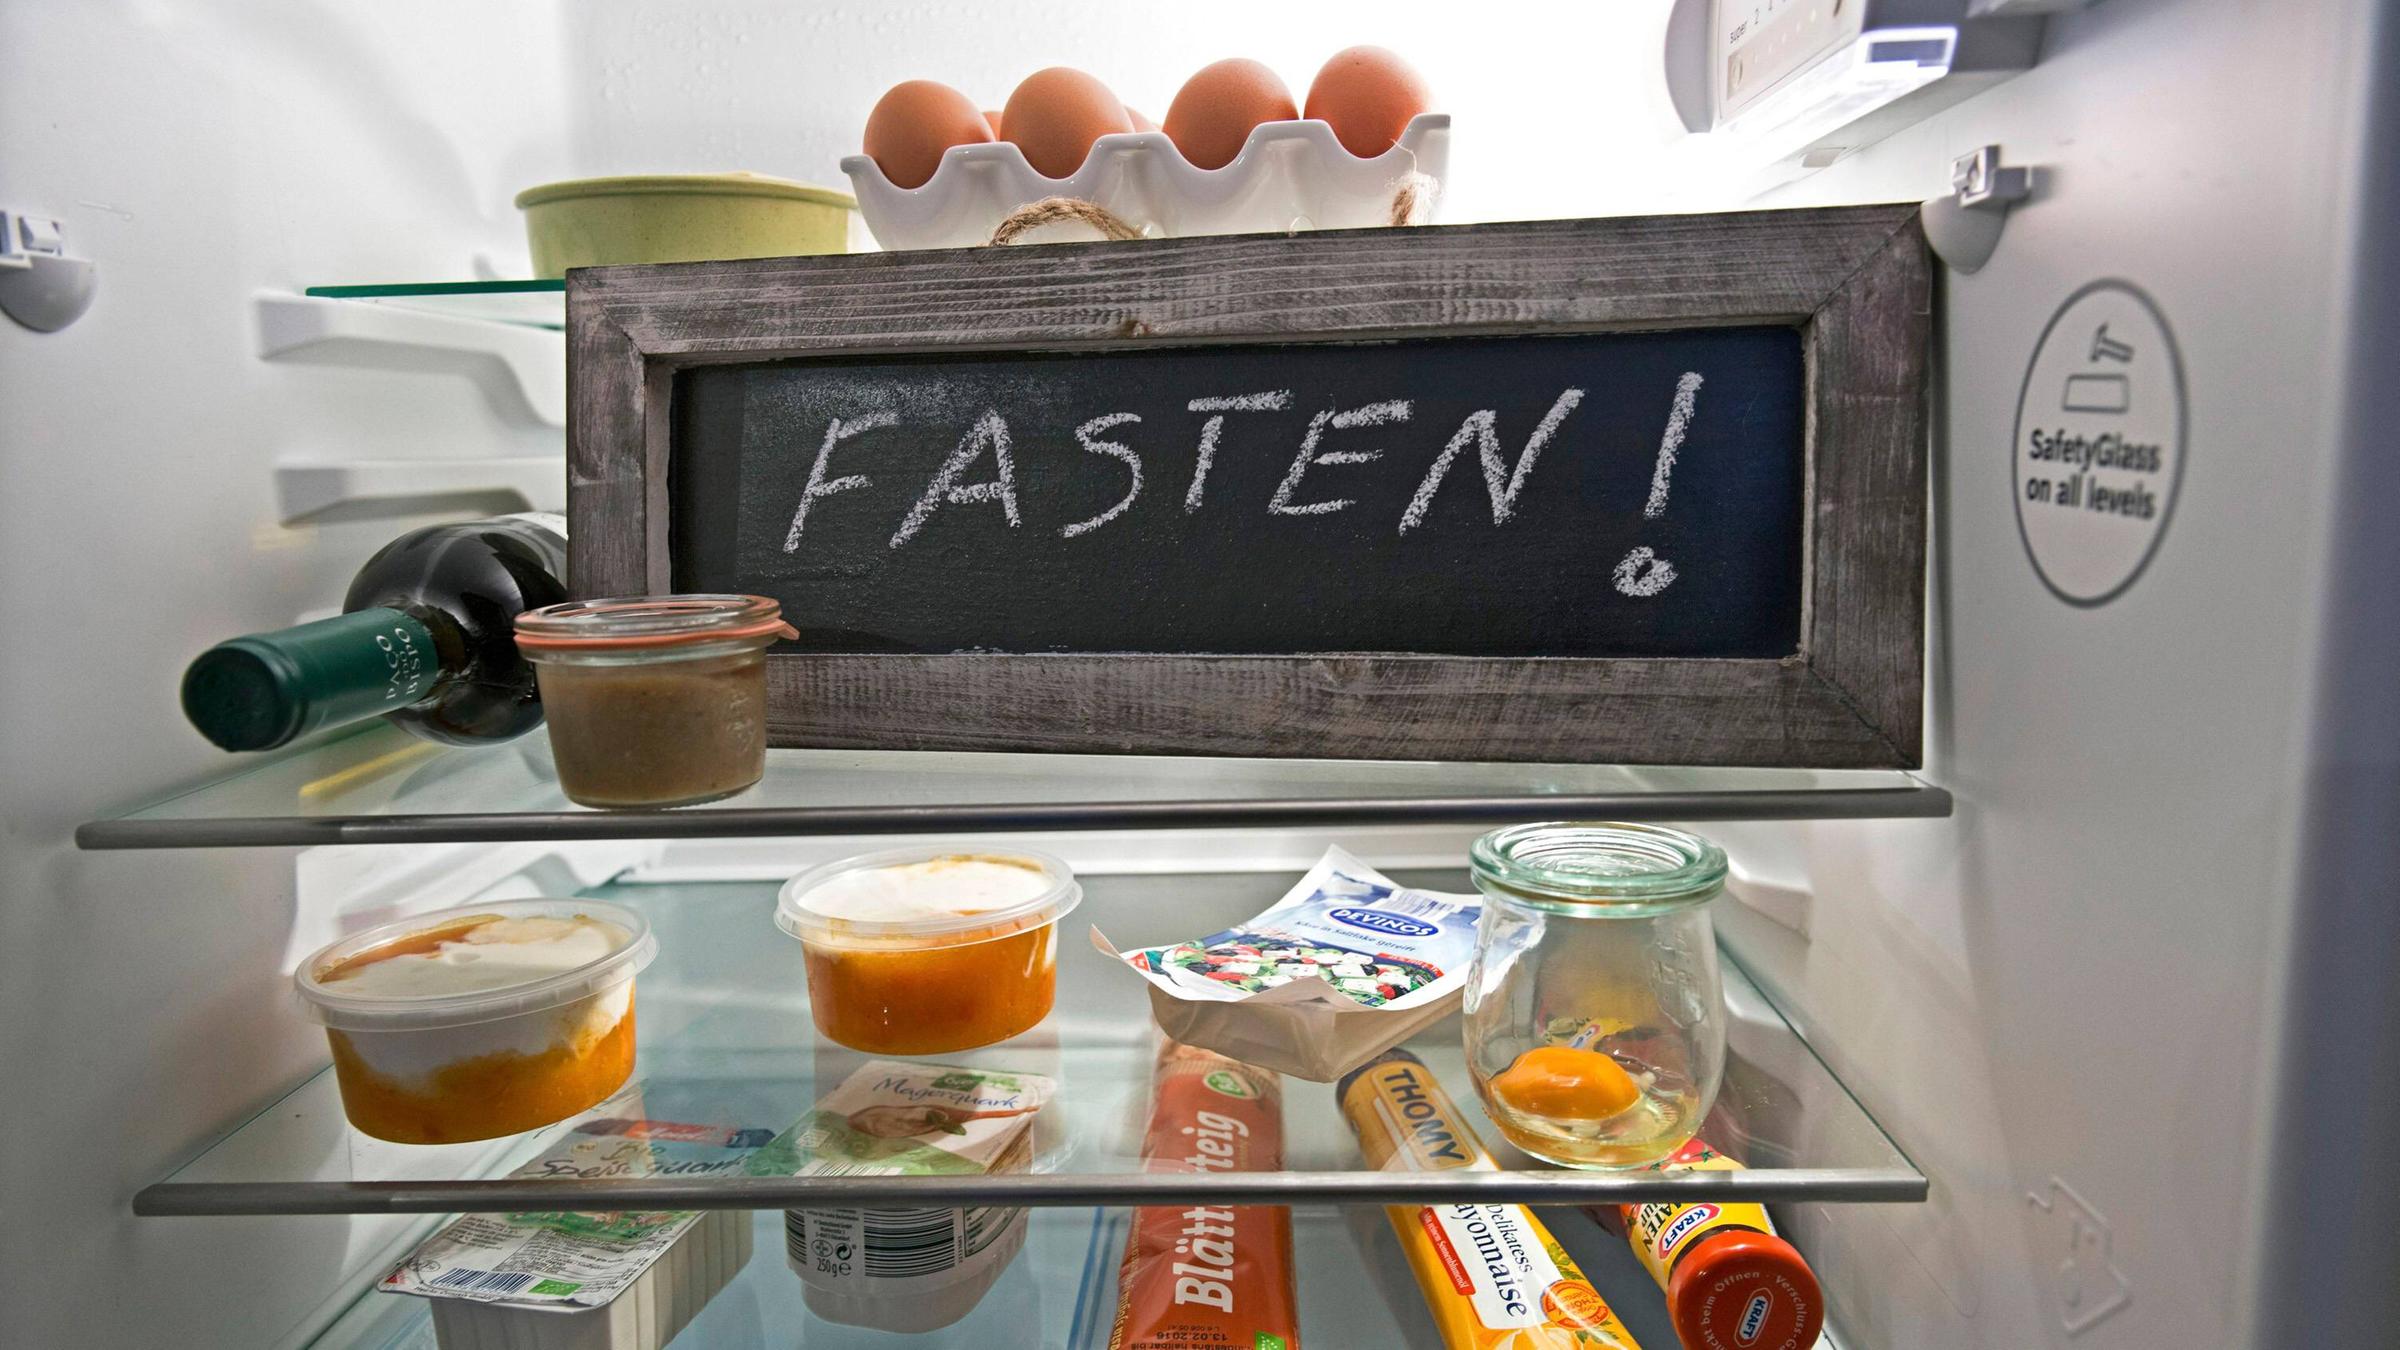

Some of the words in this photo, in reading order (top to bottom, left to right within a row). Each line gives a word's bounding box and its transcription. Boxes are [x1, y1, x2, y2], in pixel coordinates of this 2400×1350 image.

[2029, 428, 2161, 474] SafetyGlass
[2026, 475, 2051, 503] on
[2056, 473, 2083, 508] all
[2085, 475, 2156, 520] levels
[394, 627, 420, 695] BISPO
[1334, 908, 1434, 937] DEVINOS
[873, 1076, 1019, 1109] Magerquark
[1384, 1068, 1466, 1161] THOMY
[1485, 1204, 1533, 1273] Delikatess
[1664, 1209, 1706, 1249] KRAFT
[816, 1257, 831, 1273] 250
[1450, 1203, 1528, 1317] ayonnaise
[1743, 1298, 1767, 1338] KRAFT
